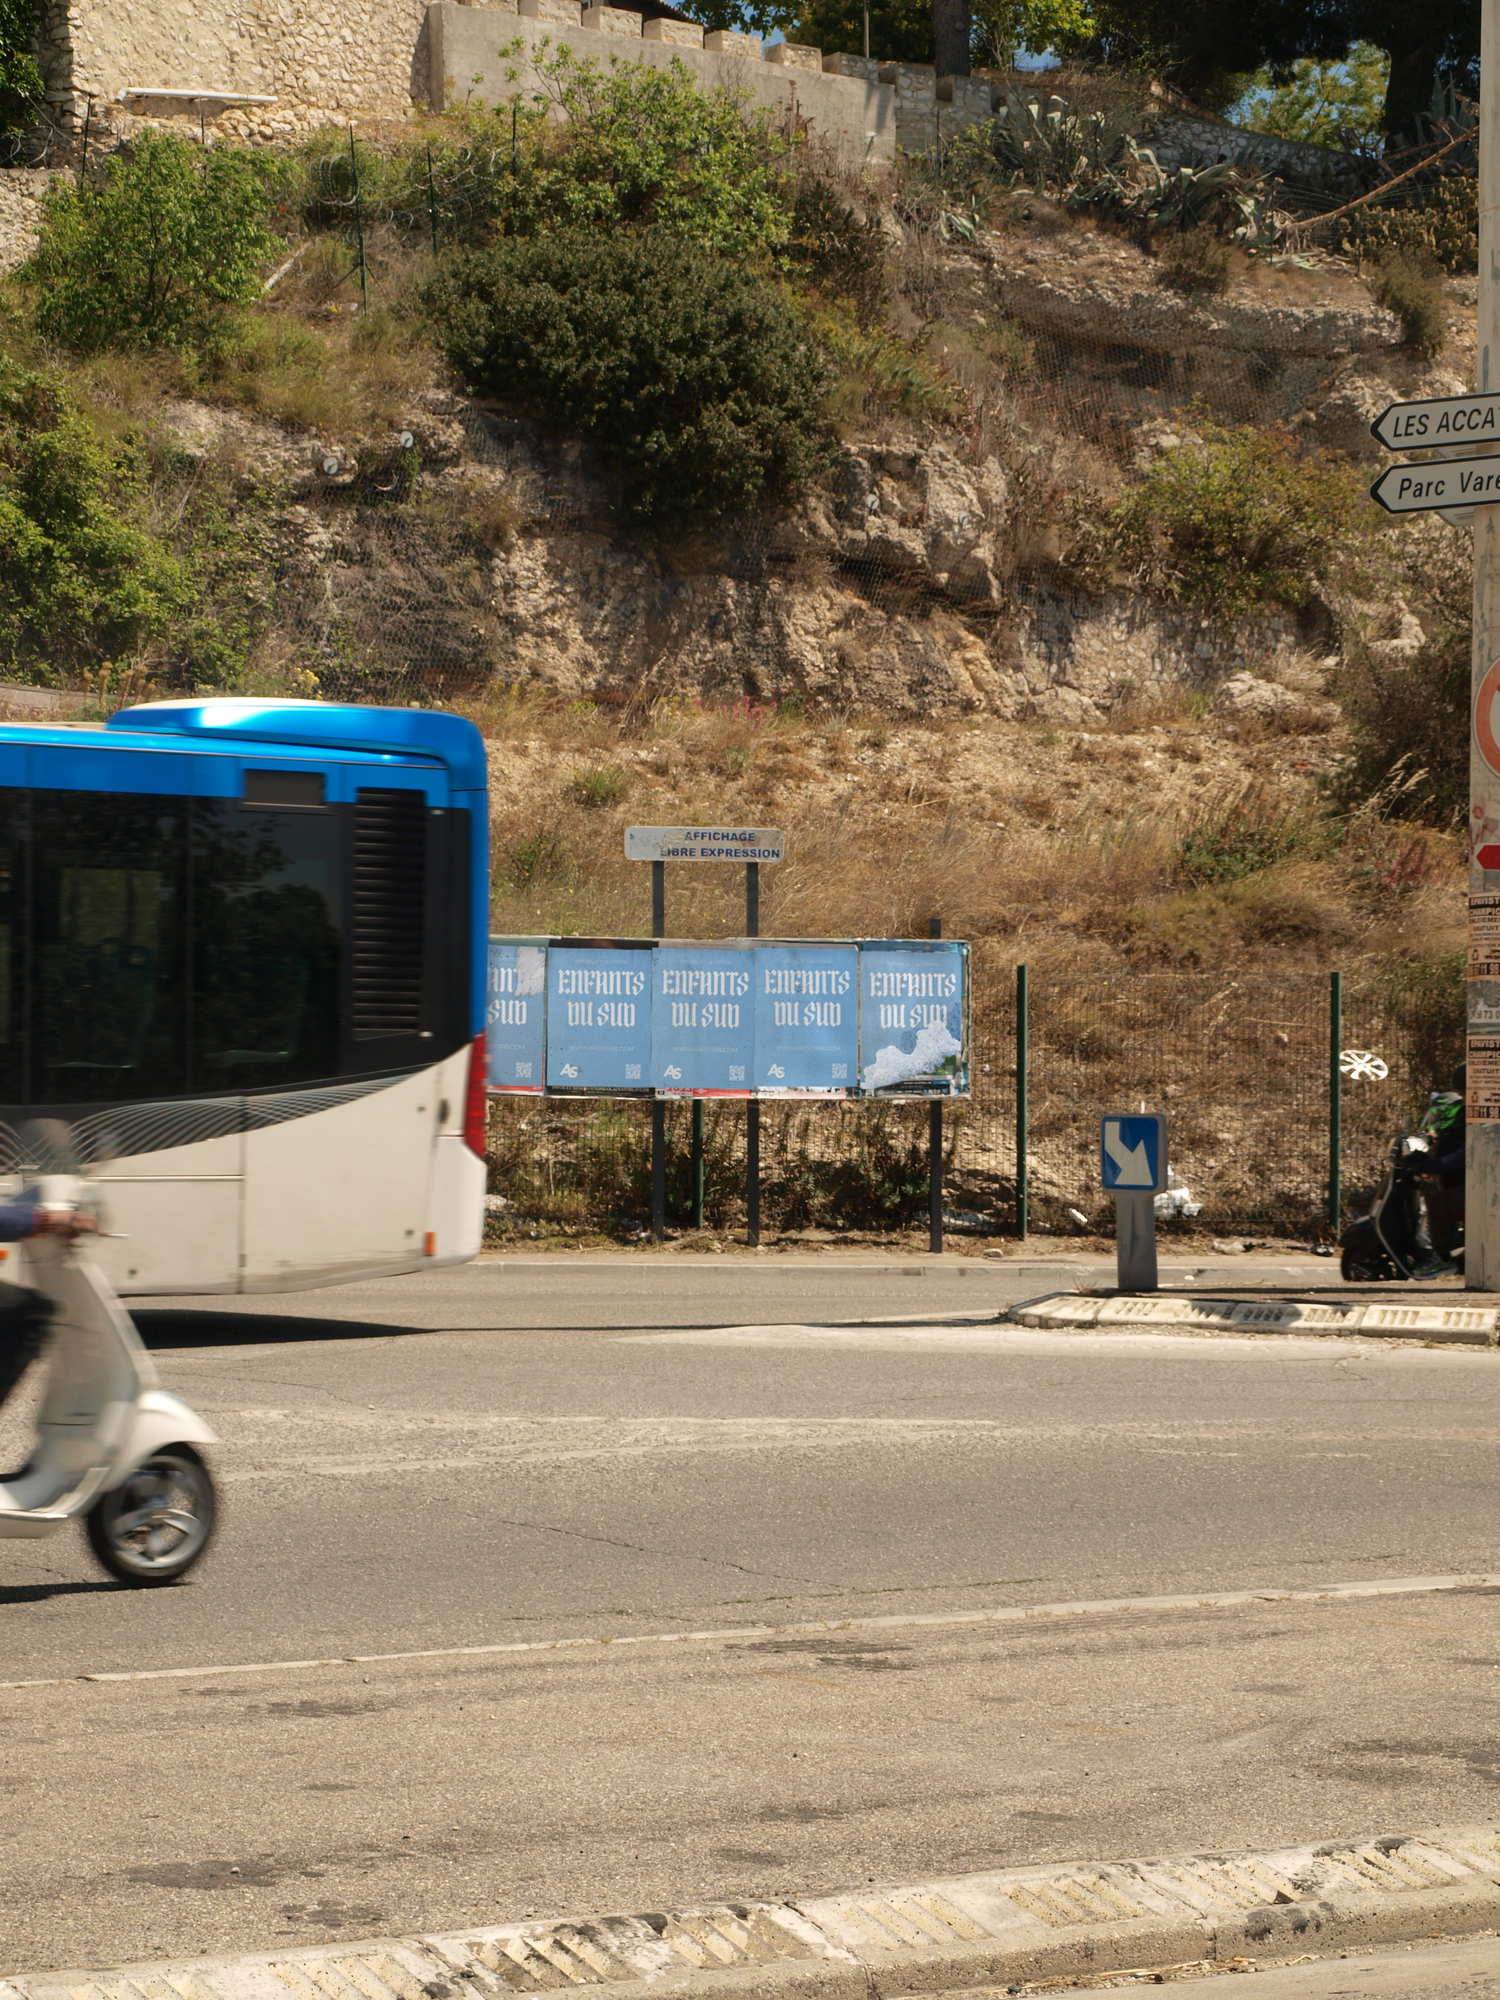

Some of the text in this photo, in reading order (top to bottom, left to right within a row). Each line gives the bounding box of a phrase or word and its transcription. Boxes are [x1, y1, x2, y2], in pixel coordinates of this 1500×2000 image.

[1393, 407, 1500, 438] LES ACCA
[1398, 478, 1445, 500] Parc
[684, 832, 755, 842] AFFICHAGE
[701, 848, 780, 858] EXPRESSION
[558, 969, 645, 996] ENFANTS
[662, 969, 750, 996] ENFANTS
[764, 969, 851, 995] ENFANTS
[869, 972, 956, 997] ENFANTS
[567, 1001, 635, 1028] DU SUD
[671, 1001, 739, 1028] DU SUD
[774, 1001, 841, 1027] DU SUD
[879, 1004, 905, 1029] DU
[1483, 1010, 1493, 1019] 73
